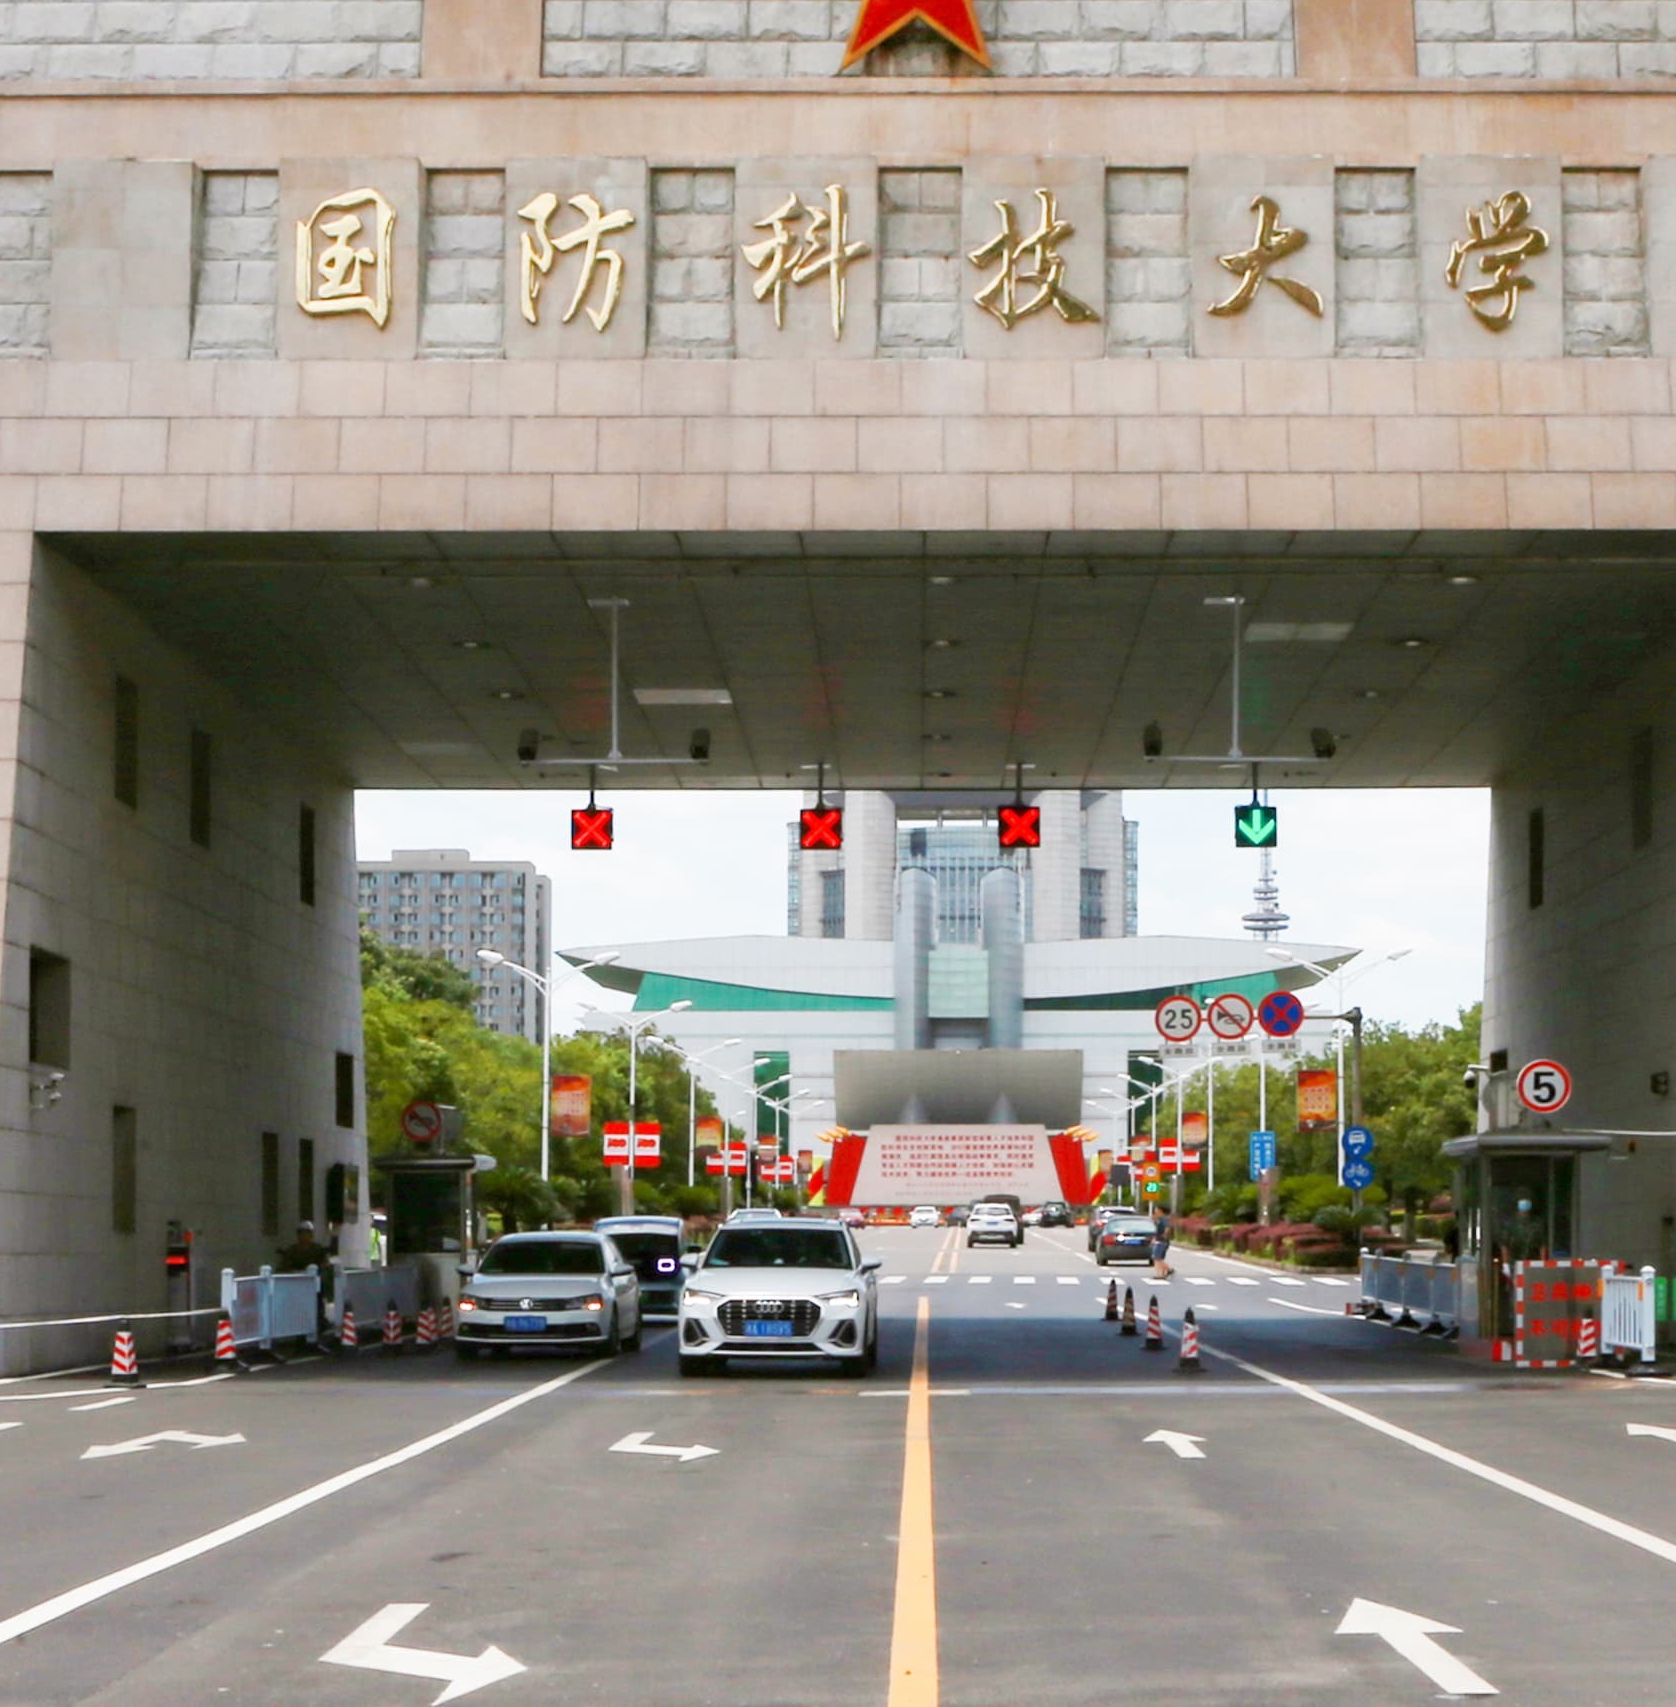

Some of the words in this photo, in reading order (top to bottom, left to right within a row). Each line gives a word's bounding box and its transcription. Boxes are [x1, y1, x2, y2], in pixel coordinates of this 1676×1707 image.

[295, 183, 1550, 341] 国防科技大学
[1164, 1008, 1193, 1031] 25
[1533, 1071, 1557, 1104] 5
